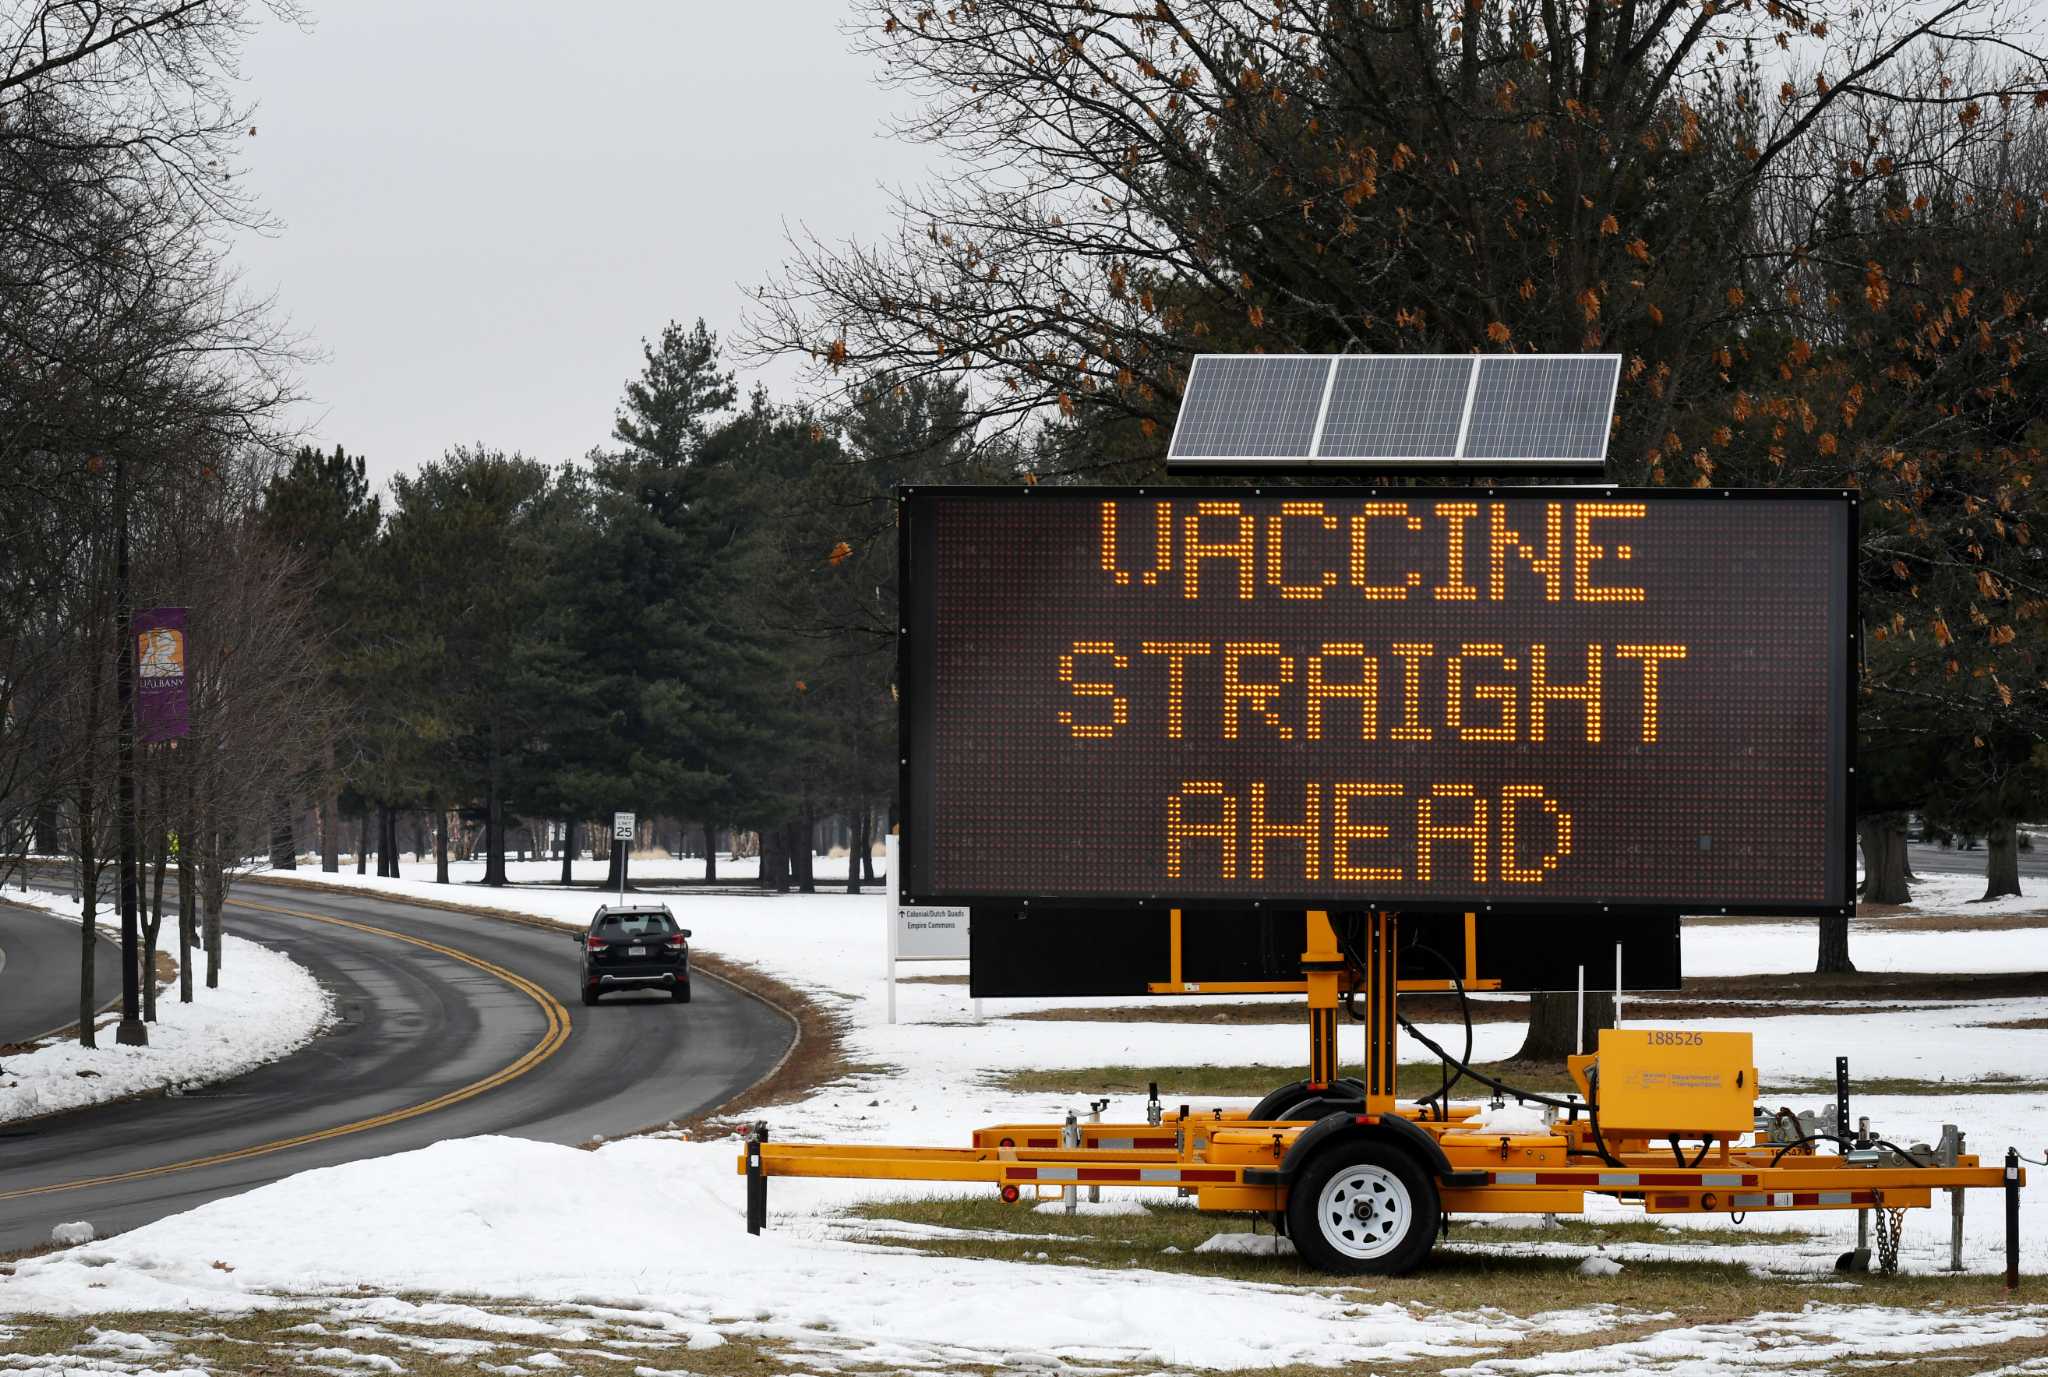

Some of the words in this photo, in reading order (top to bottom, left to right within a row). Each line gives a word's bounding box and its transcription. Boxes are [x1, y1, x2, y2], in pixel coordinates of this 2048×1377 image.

[1102, 502, 1646, 601] VACCINE
[1059, 641, 1687, 742] STRAIGHT
[616, 826, 632, 837] 25
[1167, 782, 1572, 882] AHEAD
[1647, 1032, 1704, 1046] 188526
